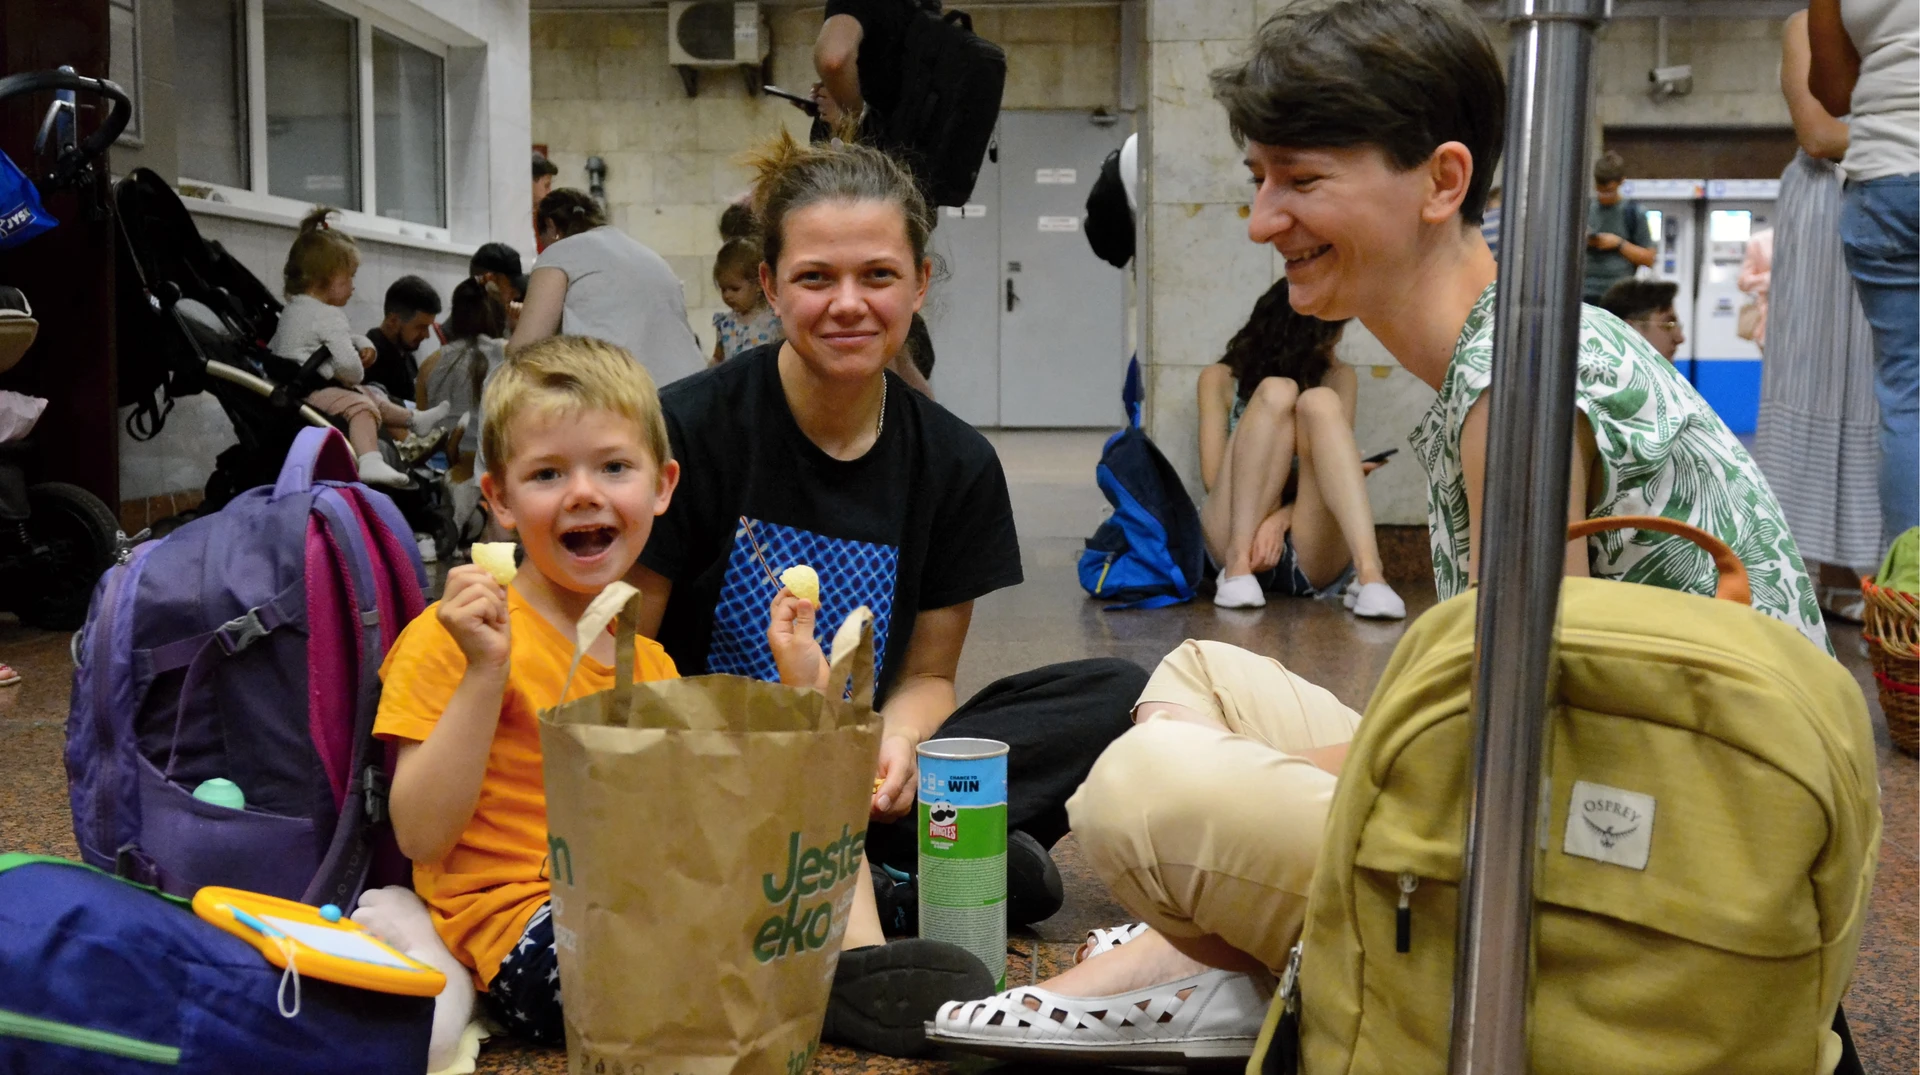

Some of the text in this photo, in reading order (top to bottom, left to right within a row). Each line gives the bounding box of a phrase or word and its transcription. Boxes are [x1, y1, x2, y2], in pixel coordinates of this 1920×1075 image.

[948, 780, 979, 792] WIN
[1583, 799, 1642, 822] OSPREY
[929, 822, 956, 840] PRINGLES
[752, 893, 833, 964] eko
